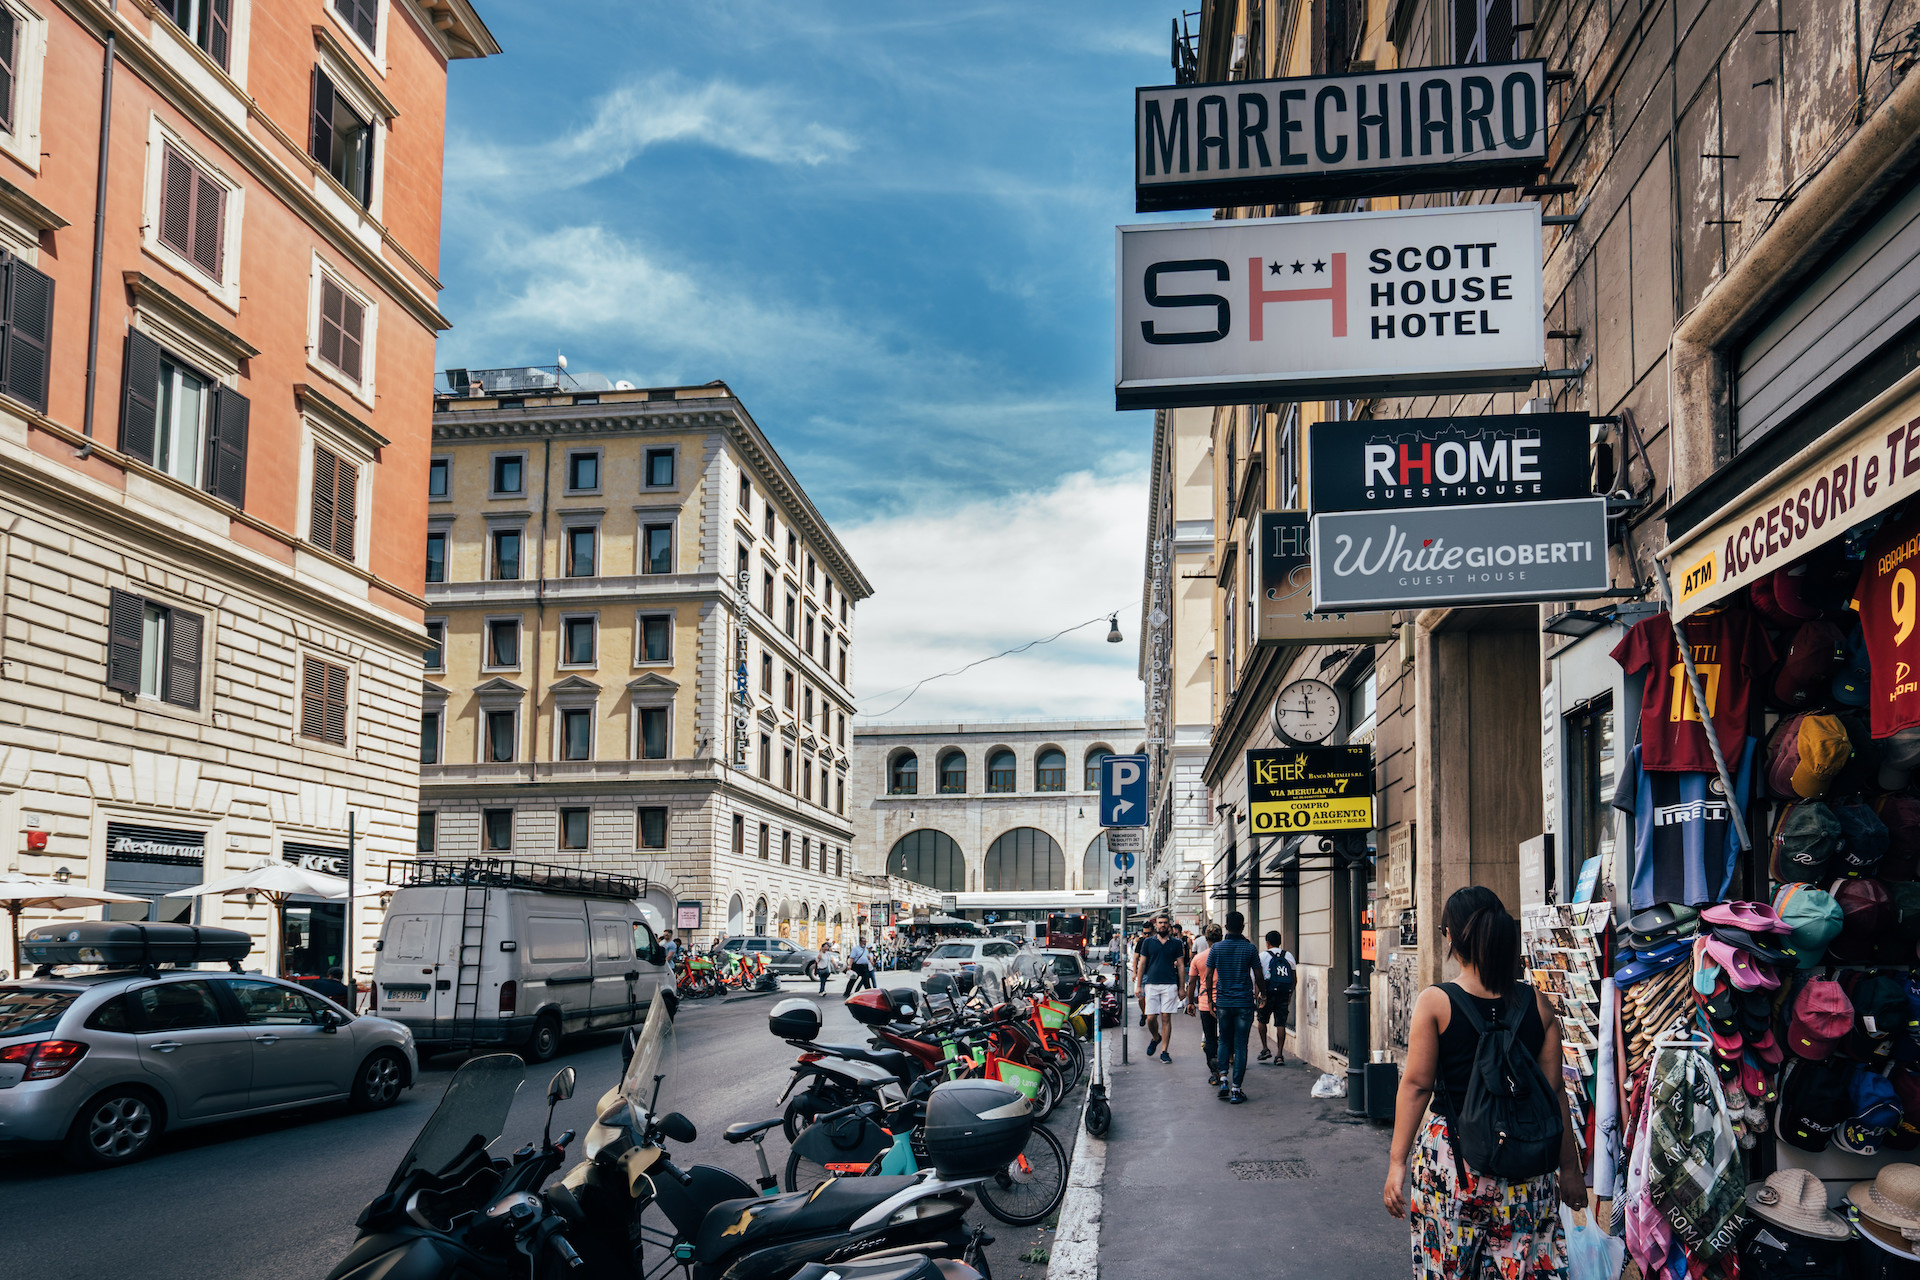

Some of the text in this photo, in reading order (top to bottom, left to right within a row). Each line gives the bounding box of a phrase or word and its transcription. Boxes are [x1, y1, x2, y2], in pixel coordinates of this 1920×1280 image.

[1145, 71, 1537, 176] MARECHIARO
[1368, 242, 1498, 275] SCOTT
[1140, 252, 1348, 345] SH
[1370, 274, 1513, 308] HOUSE
[1371, 309, 1500, 340] HOTEL
[1364, 438, 1542, 487] RHOME
[1366, 484, 1542, 500] GUESTHOUSE
[1684, 560, 1712, 596] ATM
[1722, 454, 1858, 583] ACCESSORI
[1863, 455, 1880, 498] e
[1333, 524, 1592, 578] White GIOBERTI
[1399, 571, 1527, 586] GUEST HOUSE
[1891, 567, 1917, 648] 9
[737, 662, 748, 704] ART
[1301, 684, 1313, 695] 12
[1669, 663, 1722, 722] 10
[1279, 706, 1336, 719] 9 3
[1304, 730, 1312, 740] 6
[1112, 762, 1141, 796] P
[1253, 759, 1305, 785] KETER
[1270, 779, 1349, 797] VIA MERULANA, 7
[1255, 809, 1366, 829] ORO ARGENTO
[1290, 802, 1330, 810] COMPRO
[1654, 799, 1730, 827] PIRELLI
[112, 837, 204, 858] Restaurant
[299, 854, 343, 872] KFC
[1667, 1205, 1705, 1252] ROMA
[1710, 1214, 1747, 1253] ROMA
